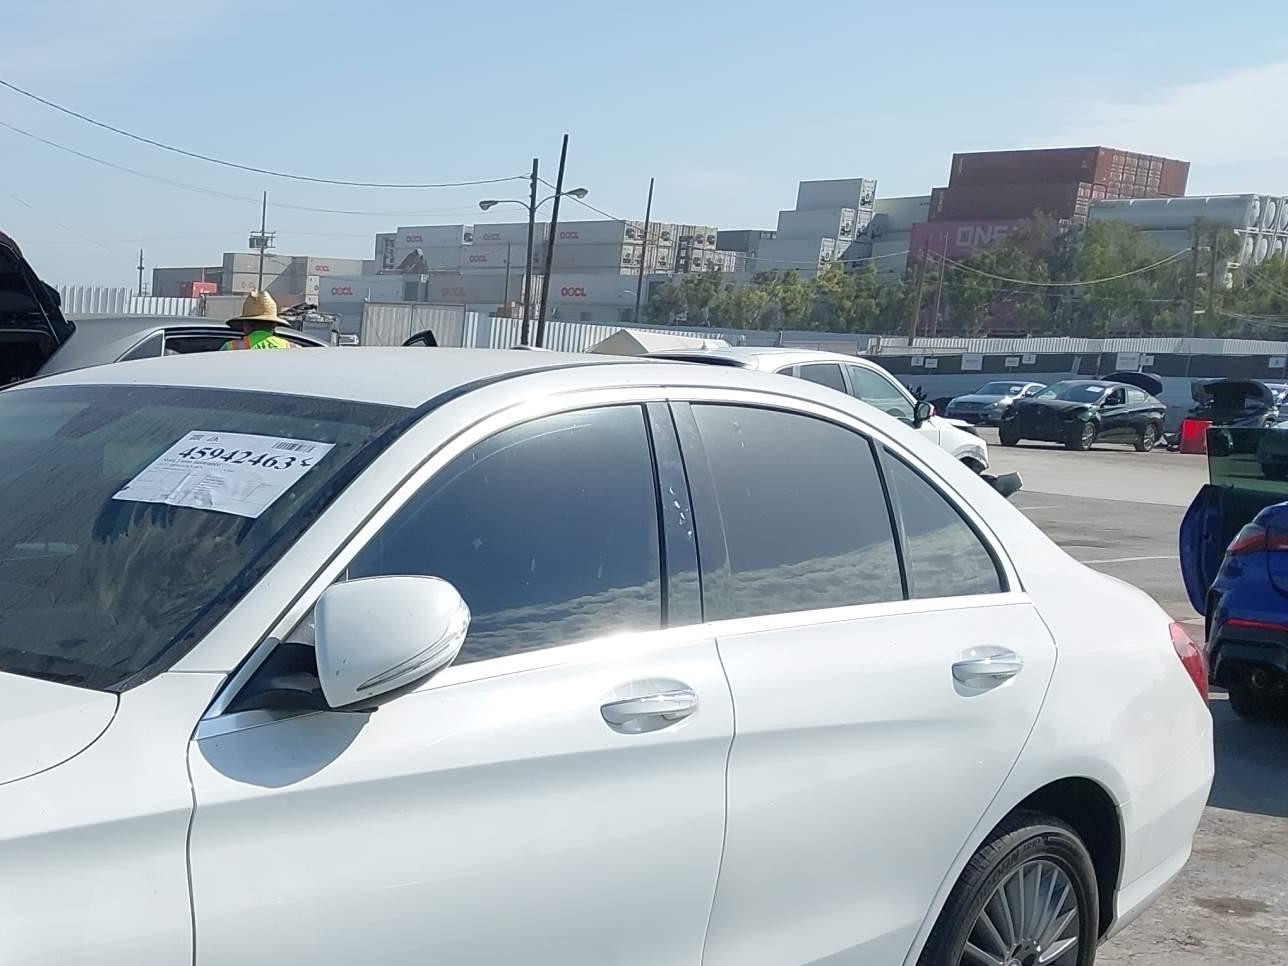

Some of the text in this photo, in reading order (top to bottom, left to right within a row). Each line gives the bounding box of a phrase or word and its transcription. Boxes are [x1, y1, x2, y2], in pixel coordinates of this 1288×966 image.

[331, 287, 353, 296] OOCL
[561, 287, 586, 296] OOCL
[179, 446, 296, 470] 45942463
